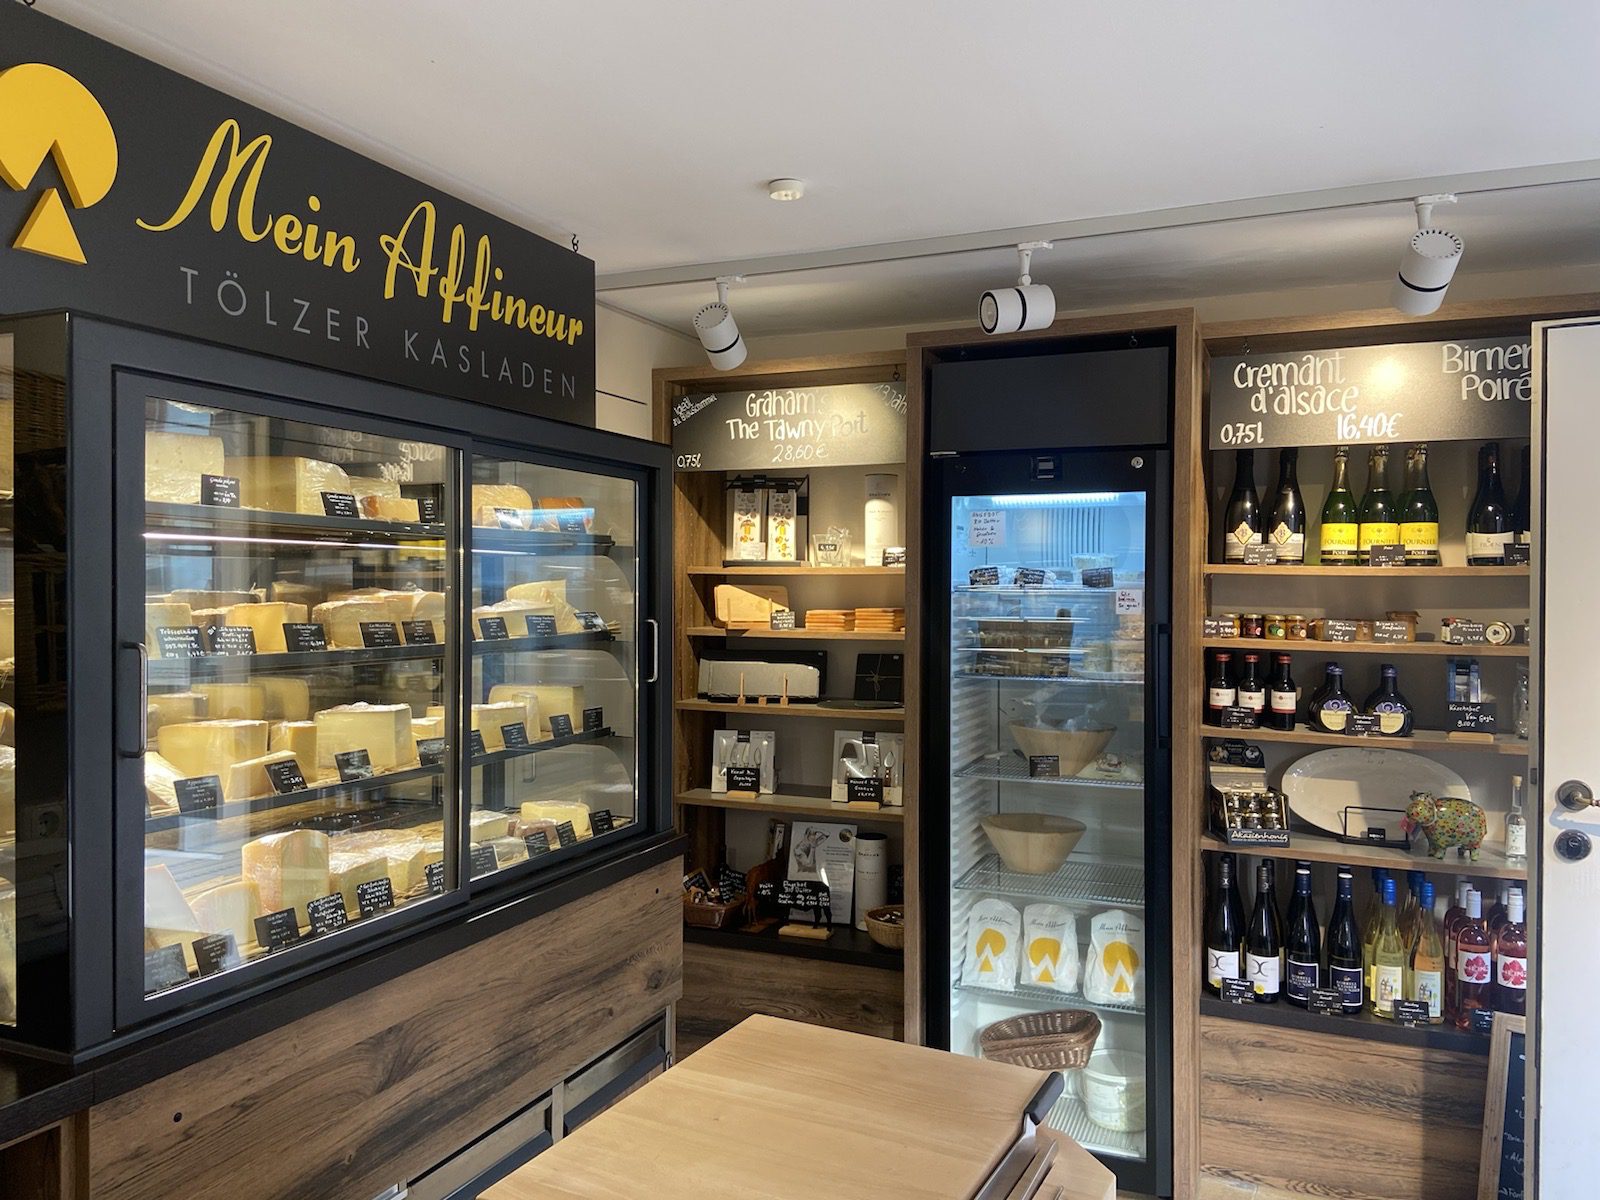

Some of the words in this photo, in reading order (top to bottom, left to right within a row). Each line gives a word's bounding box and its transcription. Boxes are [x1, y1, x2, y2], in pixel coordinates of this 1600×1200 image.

[135, 118, 360, 273] Mein
[379, 200, 584, 346] Affineur
[180, 266, 370, 349] TÖLZER
[404, 329, 576, 400] KASLADEN
[1233, 352, 1346, 388] Cremant
[726, 418, 760, 440] The
[764, 417, 827, 442] Tawny
[831, 411, 869, 438] Port
[1336, 412, 1403, 441] 16,40€
[1231, 830, 1288, 842] Akazienhonig
